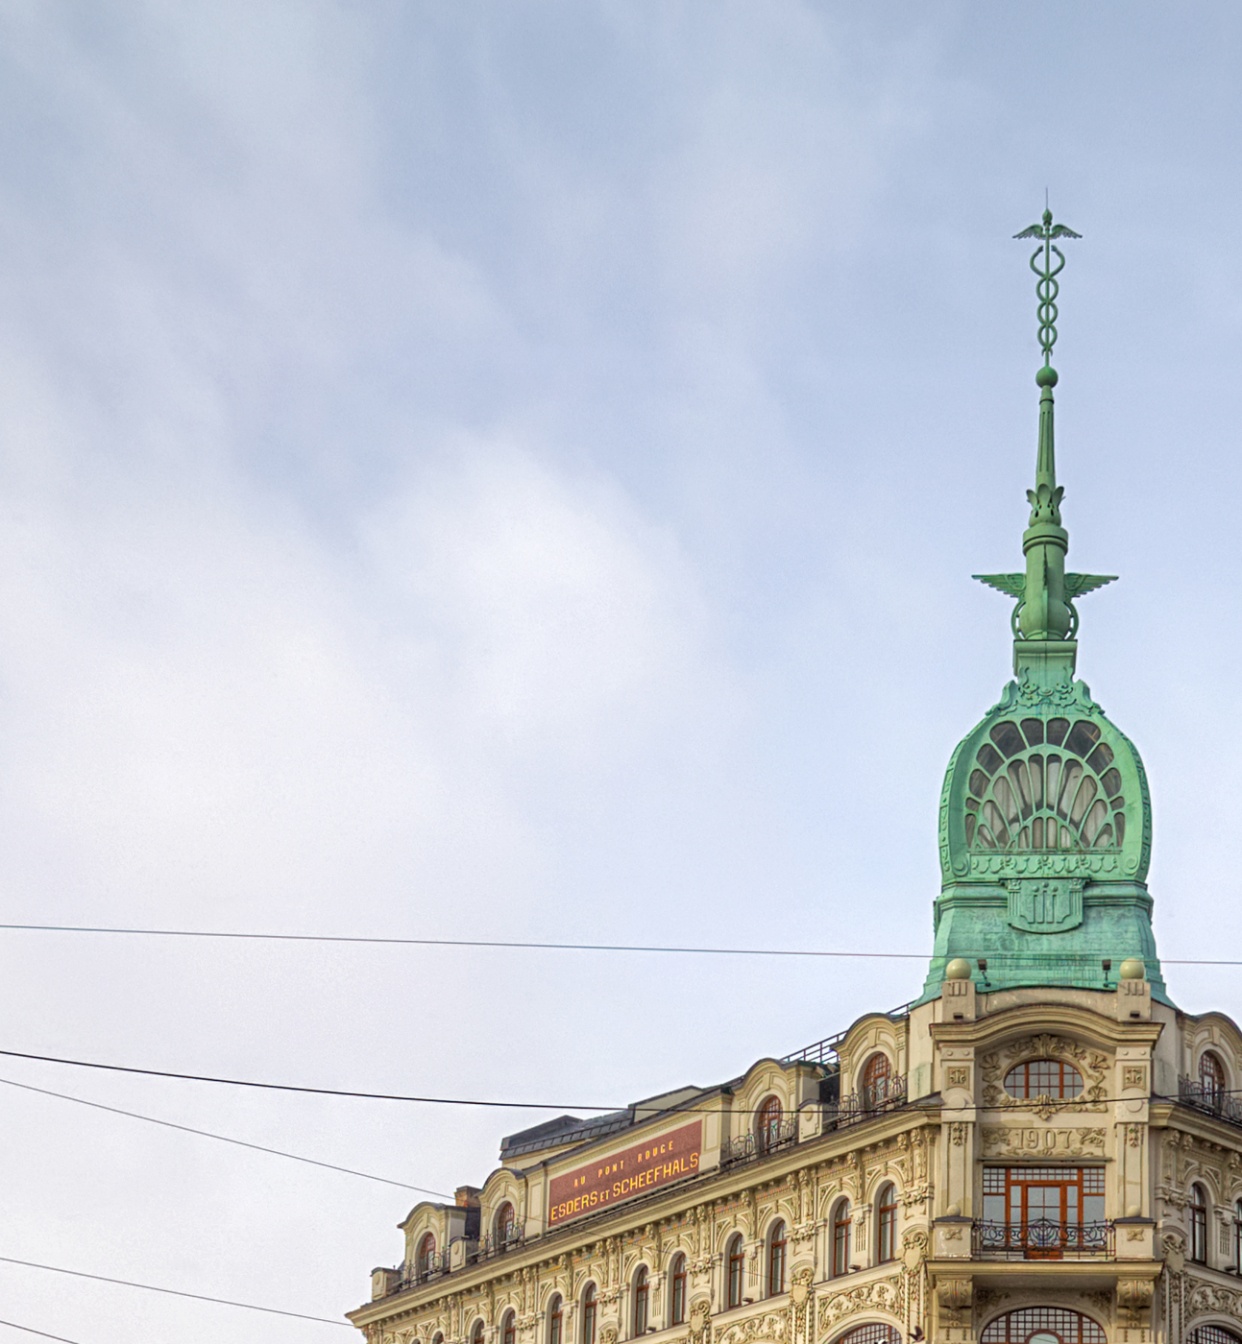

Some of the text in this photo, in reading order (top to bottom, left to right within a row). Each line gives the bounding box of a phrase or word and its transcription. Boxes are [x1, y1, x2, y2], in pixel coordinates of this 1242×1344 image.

[1014, 1129, 1073, 1150] 1907
[550, 1190, 598, 1222] ESDERS
[612, 1152, 699, 1198] SCHEEFHALS
[573, 1140, 675, 1188] AU PONT ROUGE
